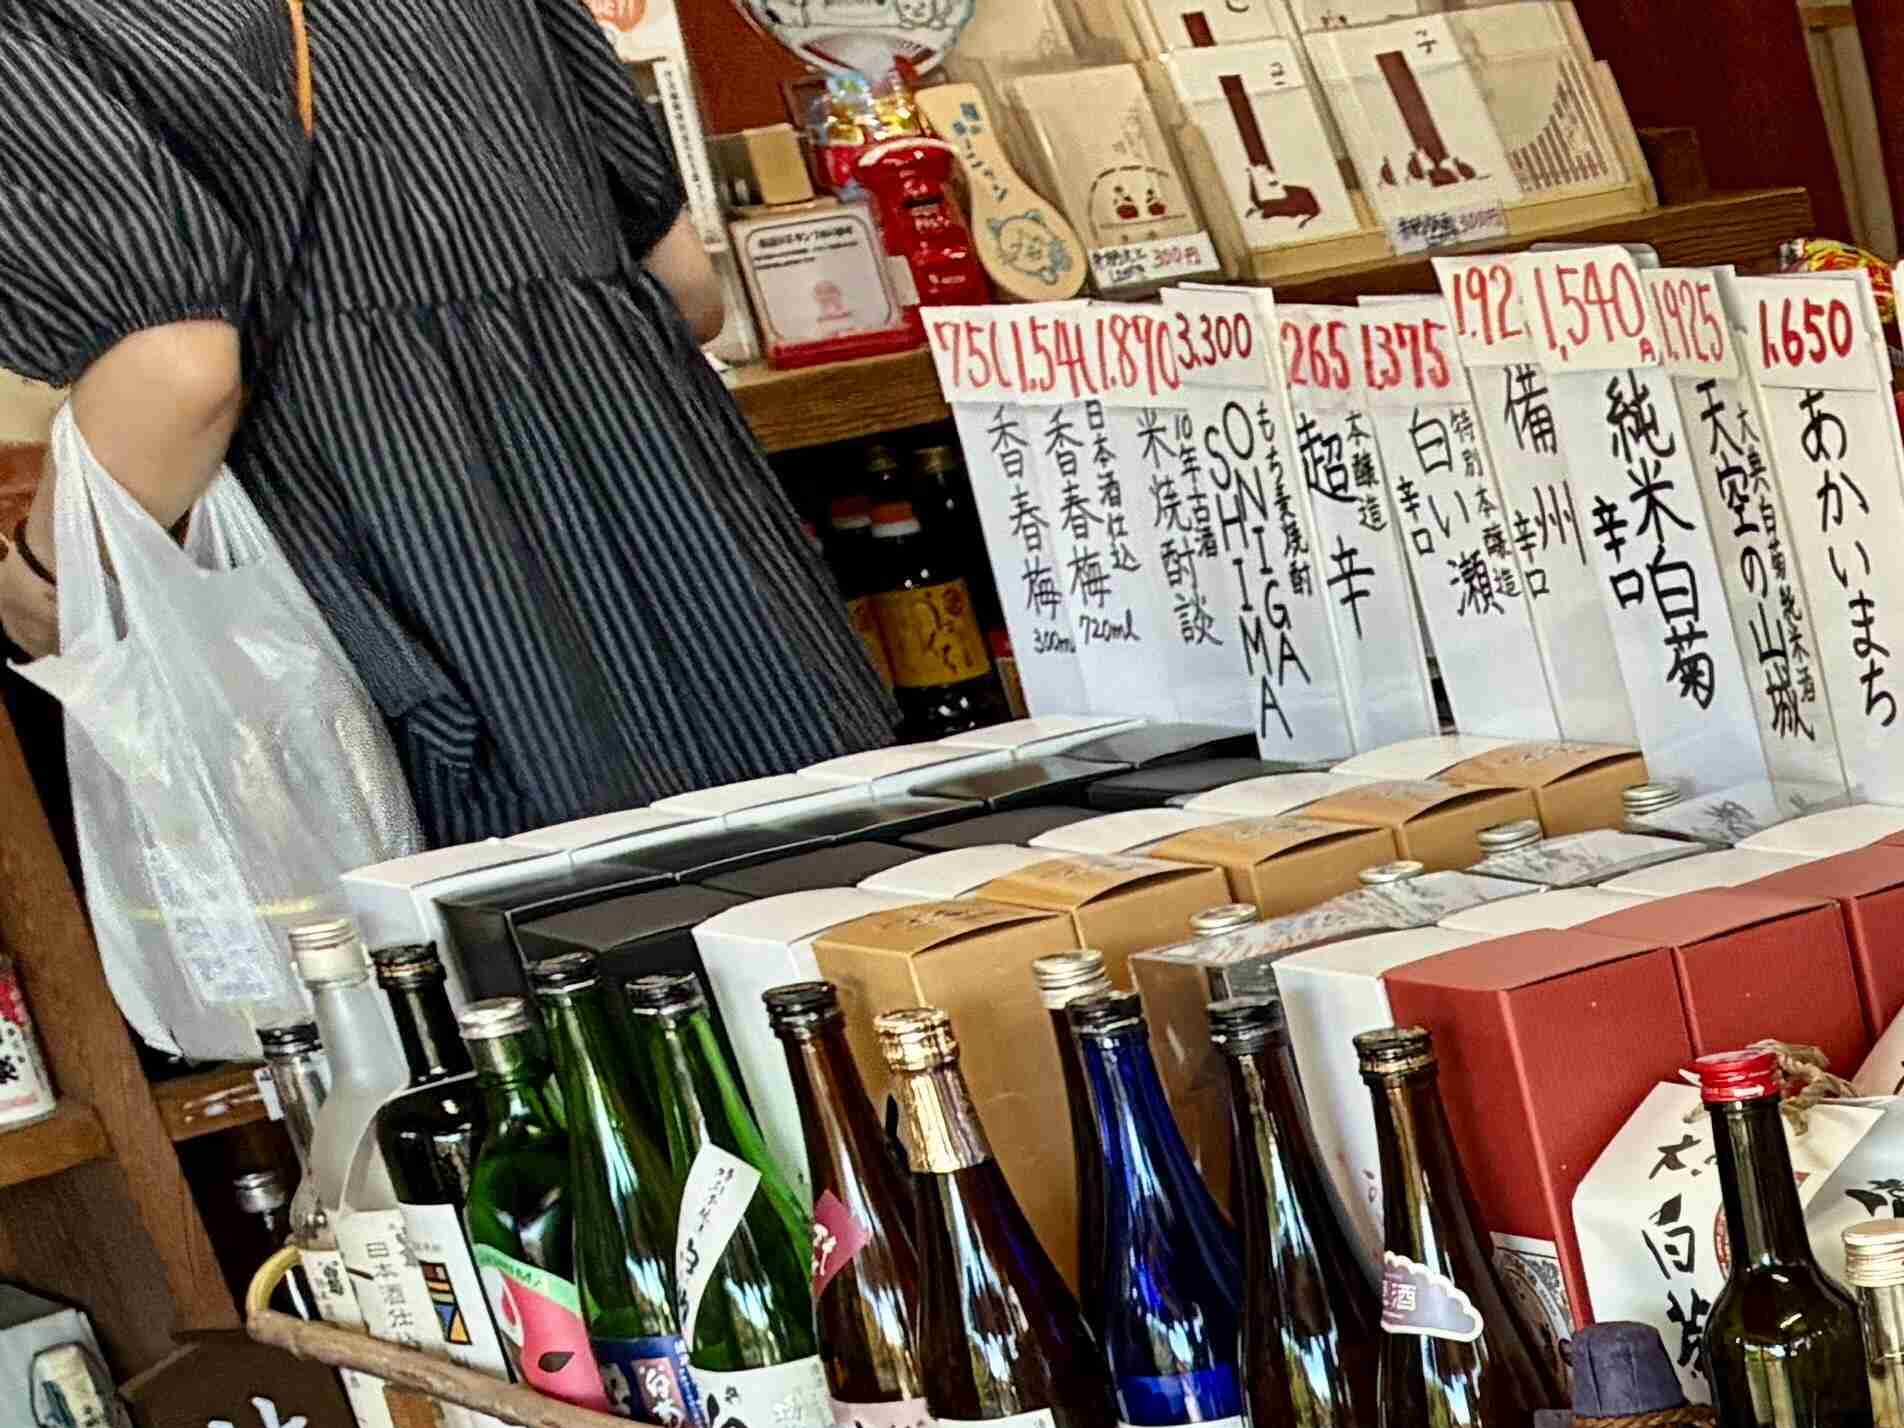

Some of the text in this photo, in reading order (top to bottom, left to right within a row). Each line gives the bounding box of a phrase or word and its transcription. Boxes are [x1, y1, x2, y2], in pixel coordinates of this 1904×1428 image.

[1593, 495, 1647, 611] 辛口
[1605, 376, 1719, 711] 純米白菊
